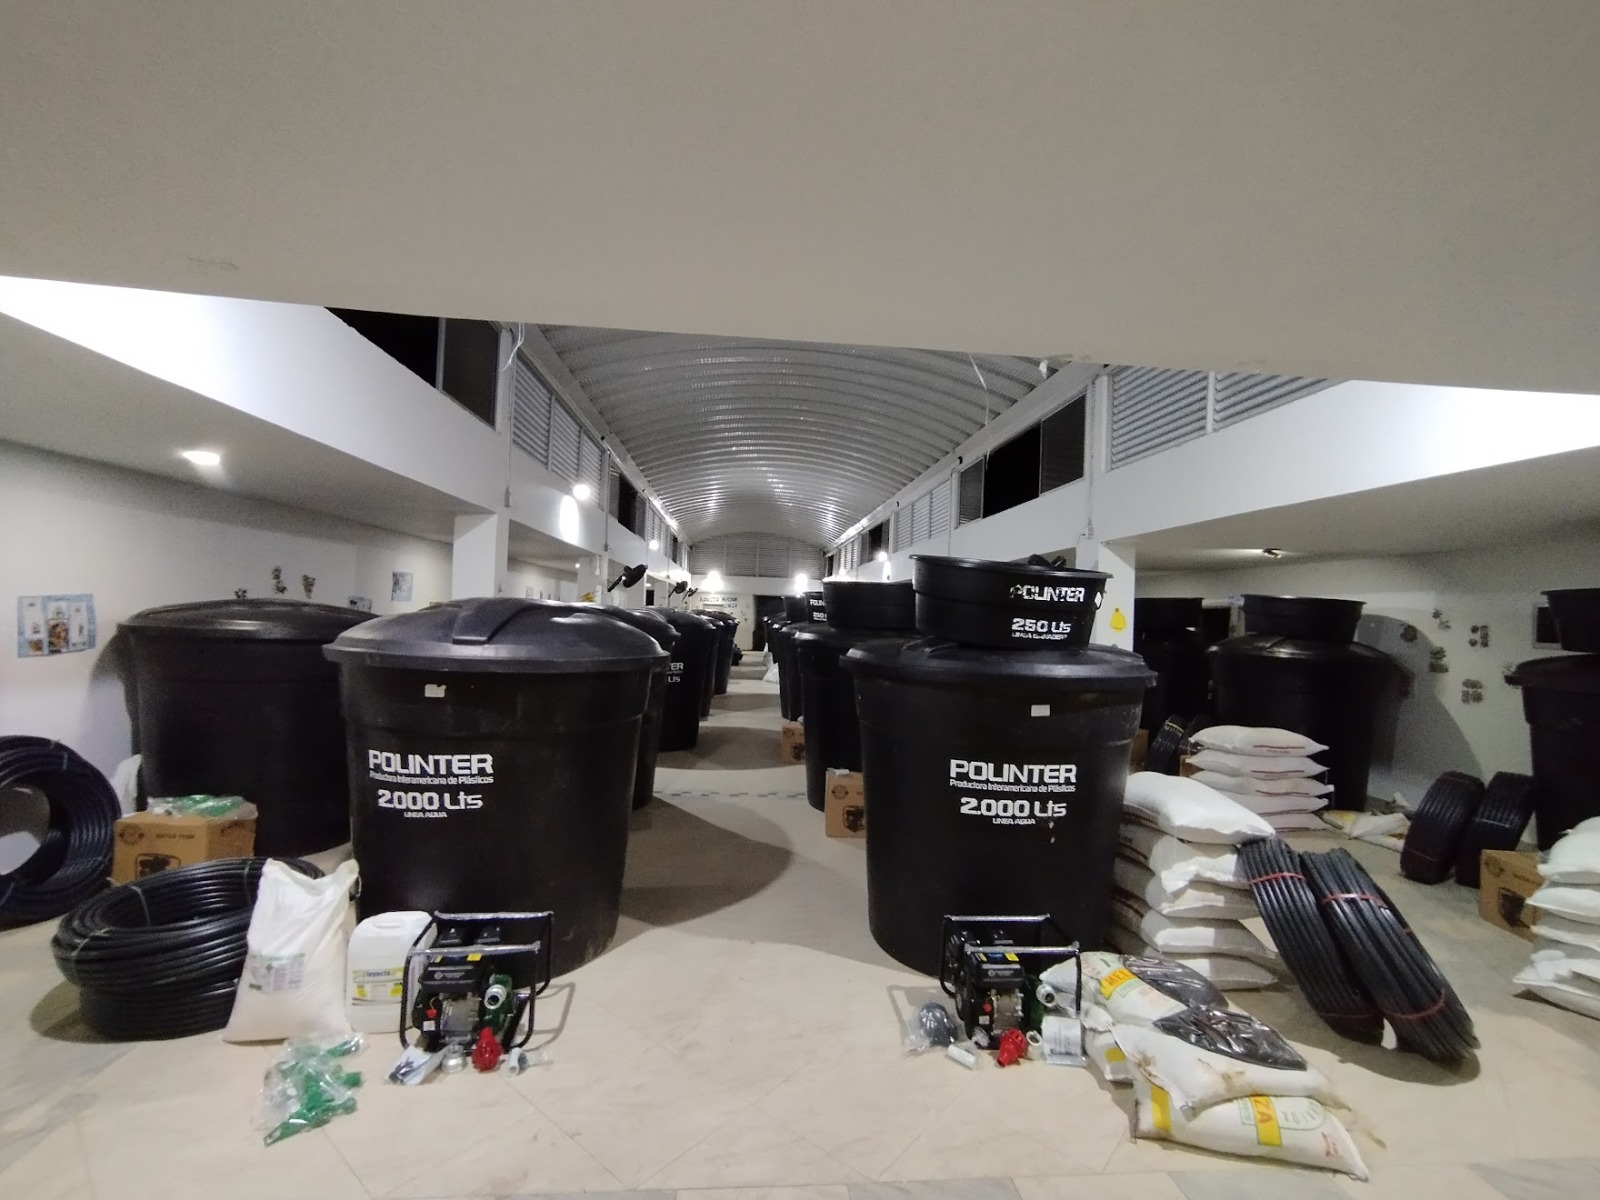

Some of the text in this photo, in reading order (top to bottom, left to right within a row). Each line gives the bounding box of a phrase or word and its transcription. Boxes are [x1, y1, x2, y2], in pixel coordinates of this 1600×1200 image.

[1009, 584, 1085, 602] POLINTER
[1011, 618, 1072, 633] 250 Lts
[368, 749, 494, 775] POLINTER
[950, 759, 1077, 783] POLINTER
[397, 775, 447, 785] Interamericana
[447, 776, 458, 785] de
[458, 775, 494, 785] Plásticos
[950, 778, 987, 790] Productora
[987, 782, 1038, 793] Interamericana
[1039, 785, 1047, 793] de
[444, 791, 483, 810] Lts
[960, 797, 1067, 817] 2.000 Lts
